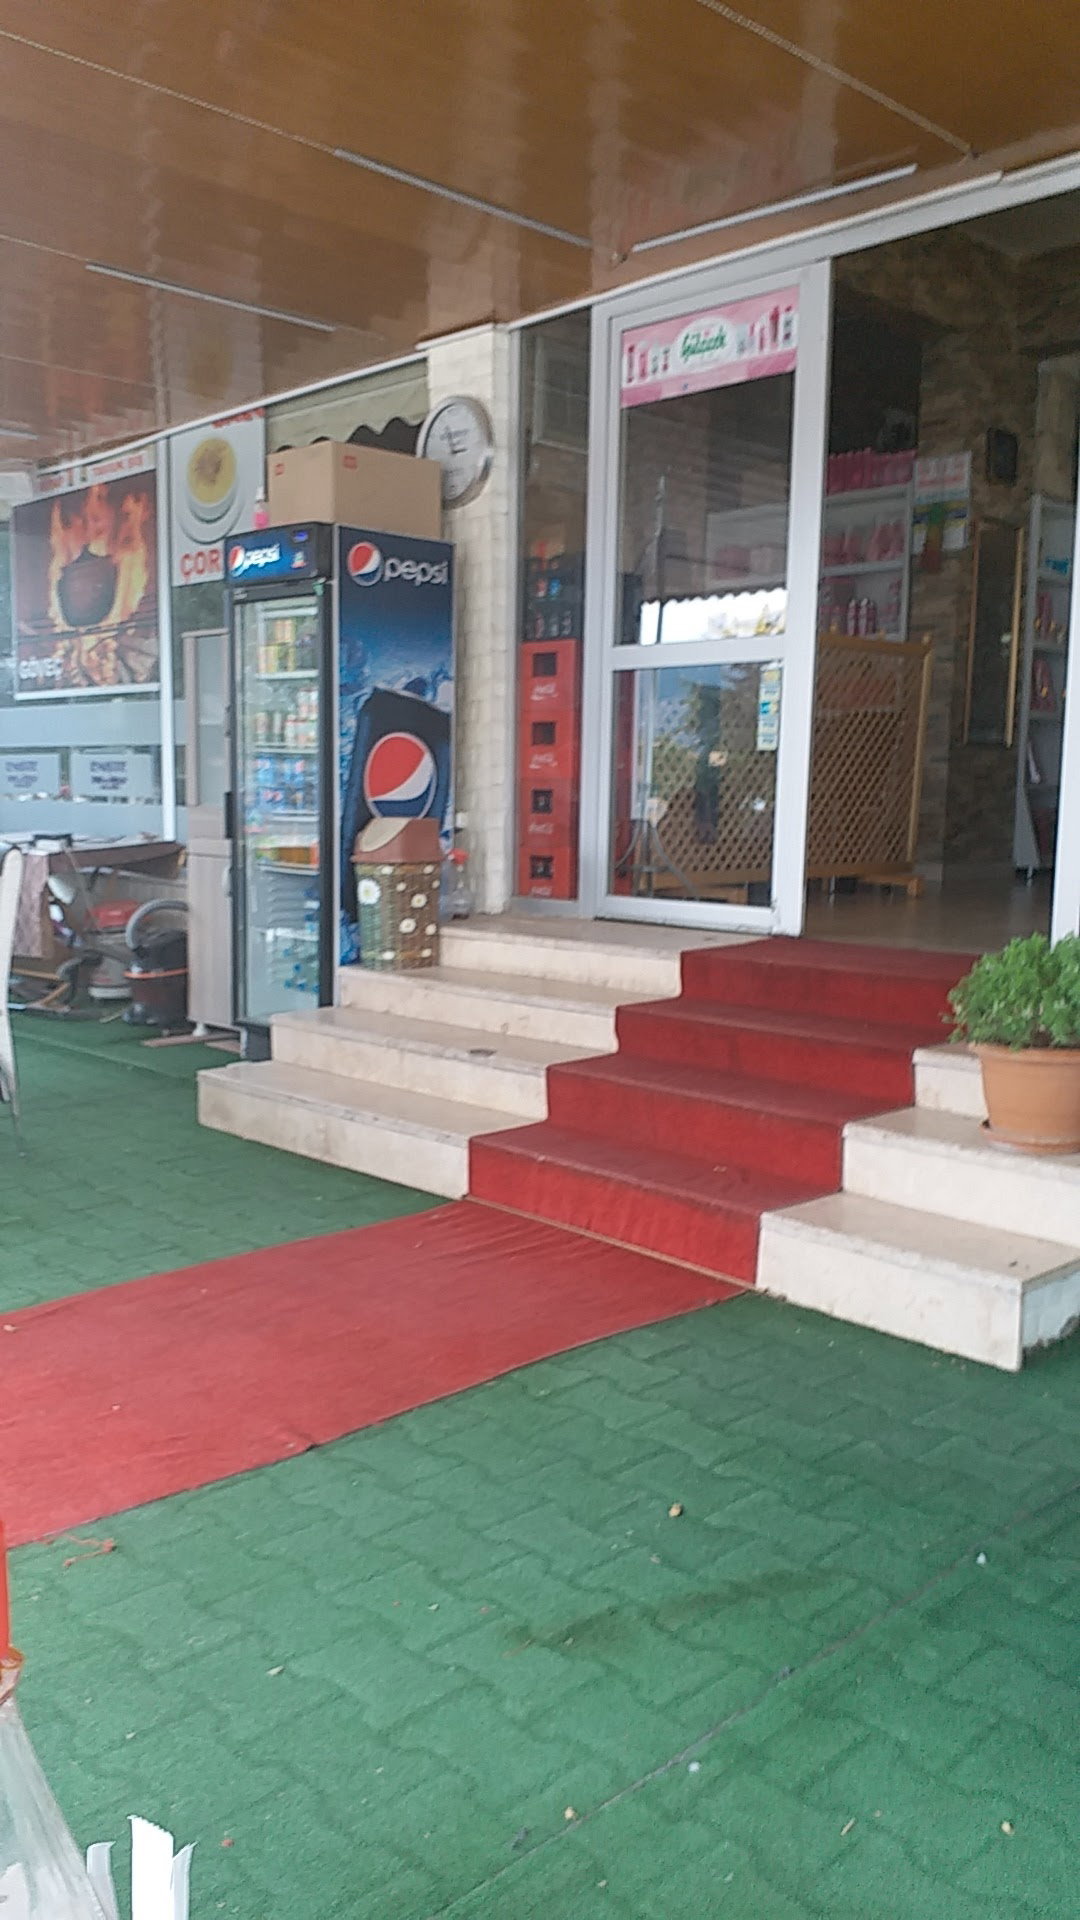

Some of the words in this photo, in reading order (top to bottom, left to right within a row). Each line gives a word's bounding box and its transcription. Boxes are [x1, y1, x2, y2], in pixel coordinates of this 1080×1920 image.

[180, 547, 222, 584] ÇOR
[242, 543, 280, 571] pepsi
[382, 556, 449, 587] pepsi
